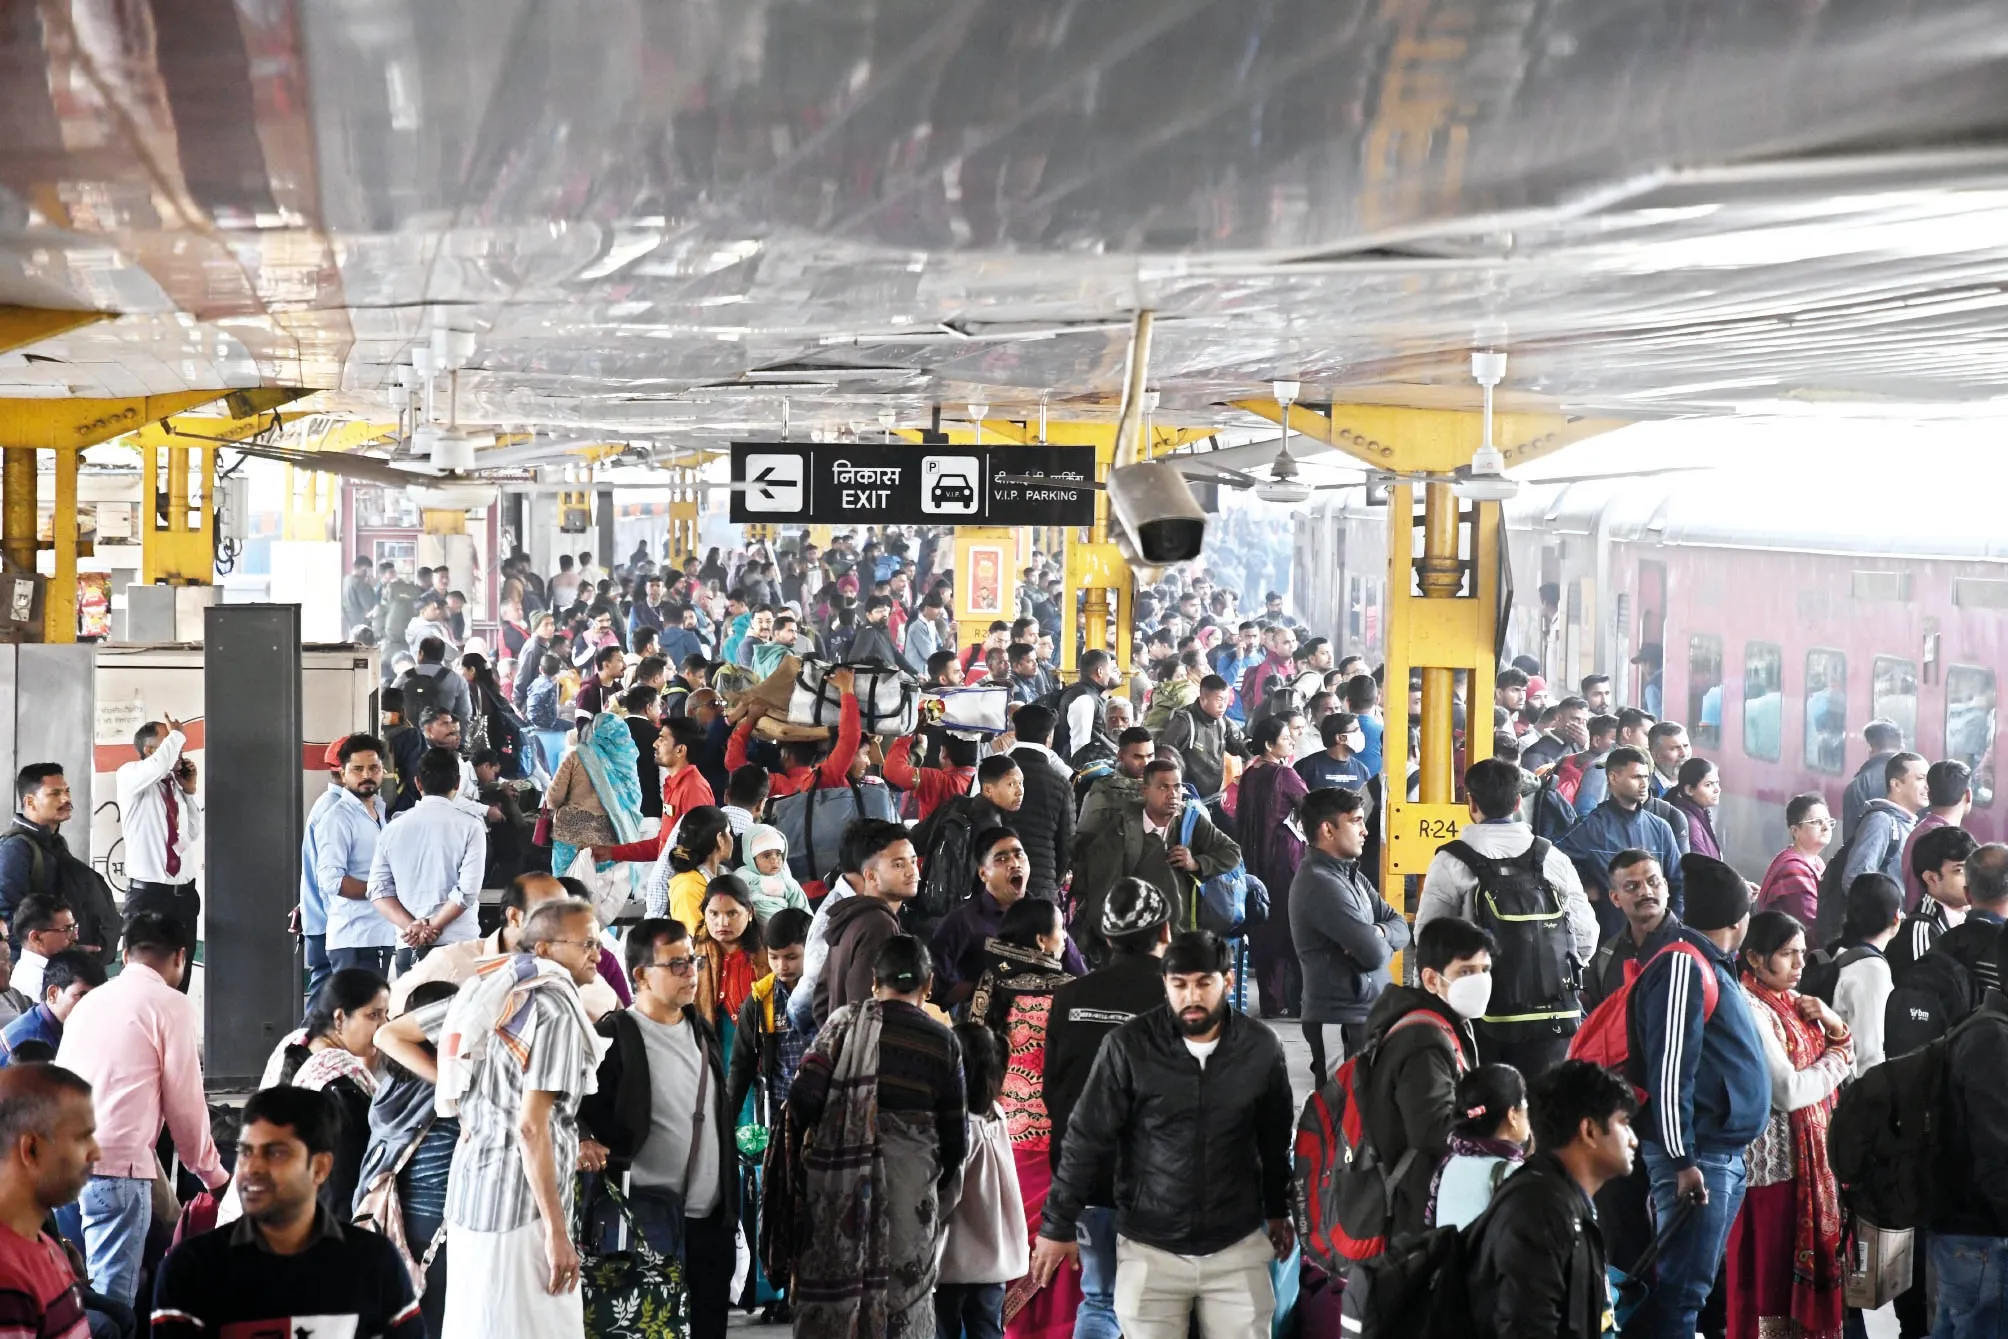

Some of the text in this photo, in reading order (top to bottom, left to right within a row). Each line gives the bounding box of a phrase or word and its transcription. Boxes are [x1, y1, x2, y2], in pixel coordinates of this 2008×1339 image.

[832, 459, 902, 485] निकास
[929, 462, 937, 473] P
[842, 489, 891, 509] EXIT
[993, 490, 1078, 501] V.I.P. PARKING
